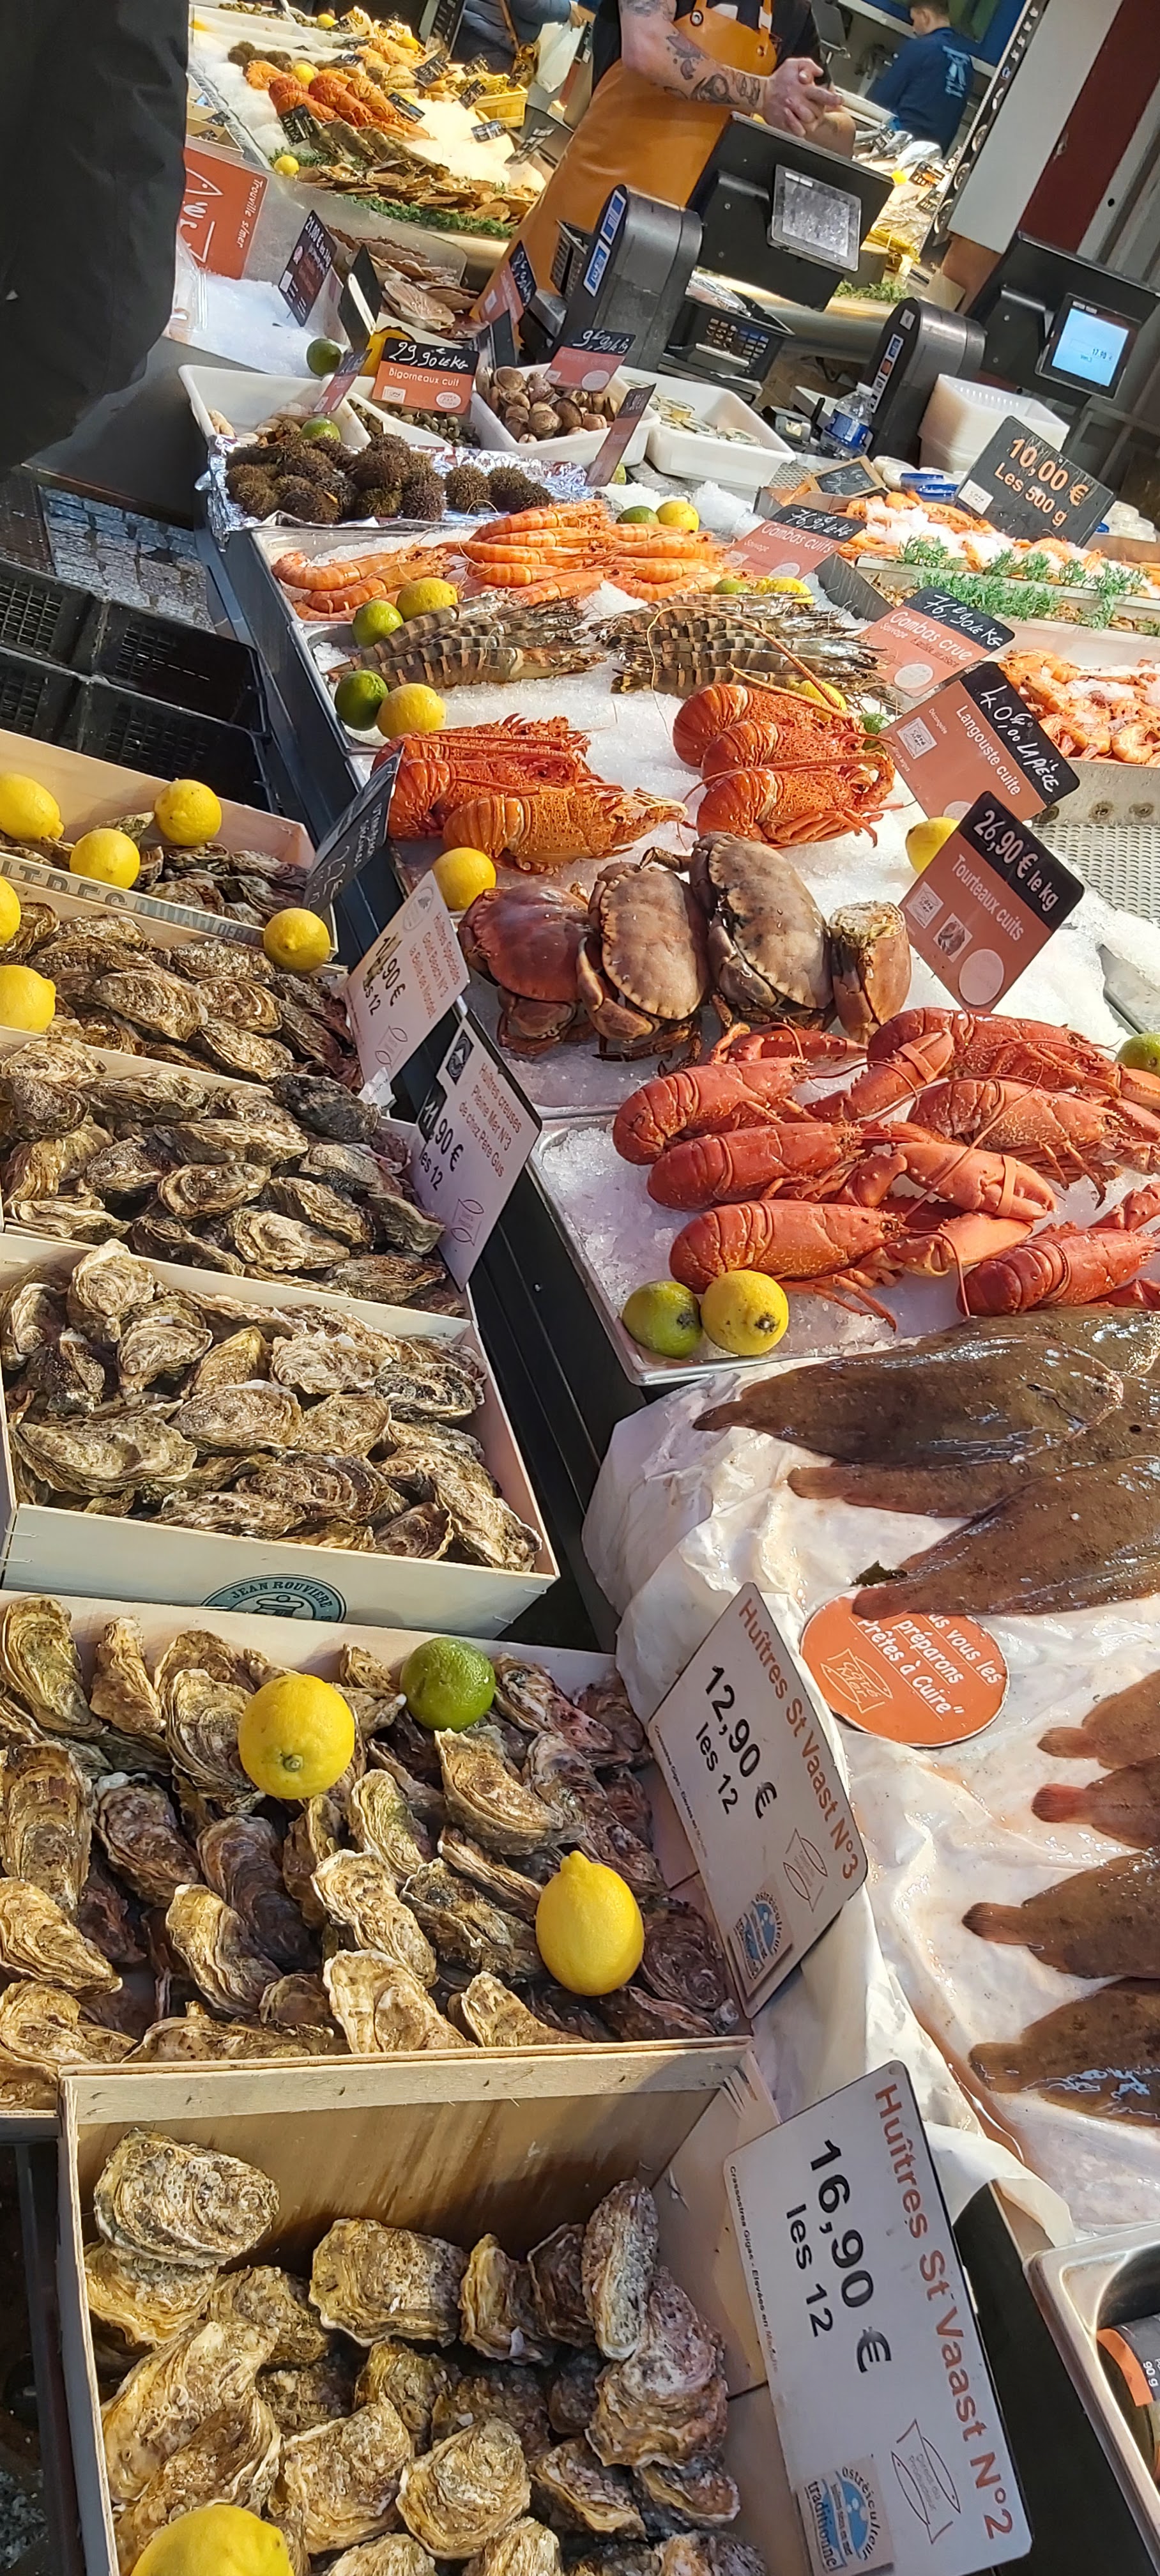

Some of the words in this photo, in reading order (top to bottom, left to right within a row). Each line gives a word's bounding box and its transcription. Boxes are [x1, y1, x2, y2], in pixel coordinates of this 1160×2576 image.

[244, 179, 264, 218] Trouville
[234, 220, 250, 249] s/mer
[388, 367, 439, 385] Bigorneaux
[441, 378, 460, 387] cuit
[994, 462, 1025, 493] Les
[1025, 485, 1056, 514] 500
[1051, 510, 1068, 527] g
[1009, 438, 1069, 491] 10,00
[1069, 483, 1089, 507] €
[761, 522, 805, 545] Gambas
[804, 537, 835, 555] cuits
[889, 611, 942, 643] Gambas
[938, 638, 973, 661] crue
[956, 705, 1001, 766] Langouste
[996, 765, 1023, 796] cuite
[973, 809, 1024, 864] 26,90
[1016, 853, 1039, 879] €
[1026, 870, 1042, 892] le
[951, 854, 1001, 915] Tourteaux
[996, 908, 1025, 941] cuits
[1038, 882, 1060, 912] kg
[368, 993, 382, 1016] 12
[390, 983, 406, 1008] €
[470, 1084, 491, 1118] Pleine
[487, 1112, 501, 1136] Mer
[478, 1062, 501, 1100] Huîtres
[498, 1095, 523, 1134] creuses
[449, 1143, 464, 1172] €
[458, 1101, 468, 1118] de
[465, 1113, 482, 1140] chez
[477, 1131, 494, 1160] Père
[491, 1151, 505, 1178] Gus
[429, 1165, 445, 1192] 12
[231, 1581, 269, 1599] JEAN
[857, 1619, 905, 1662] Prêtes
[899, 1659, 921, 1676] à
[891, 1620, 965, 1684] préparons
[946, 1629, 981, 1660] vous
[975, 1659, 1002, 1684] les
[842, 1660, 881, 1698] Côté
[702, 1665, 762, 1779] 12,90
[753, 1781, 778, 1820] €
[738, 1598, 790, 1699] Huîtres
[786, 1697, 809, 1738] St
[800, 1736, 839, 1822] Vaast
[830, 1820, 860, 1880] N°3
[695, 1724, 719, 1772] les
[716, 1774, 739, 1816] 12
[874, 2083, 929, 2240] Huîtres
[744, 2229, 754, 2260] Gigas
[786, 2202, 814, 2271] les
[804, 2283, 835, 2339] 12
[809, 2138, 876, 2310] 16,90
[855, 2326, 893, 2374] €
[919, 2248, 957, 2303] St
[935, 2304, 986, 2444] Vaast
[1142, 2361, 1156, 2376] 90
[1148, 2376, 1159, 2388] g
[841, 2465, 881, 2561] ostréiculteur
[969, 2453, 1014, 2542] N°2
